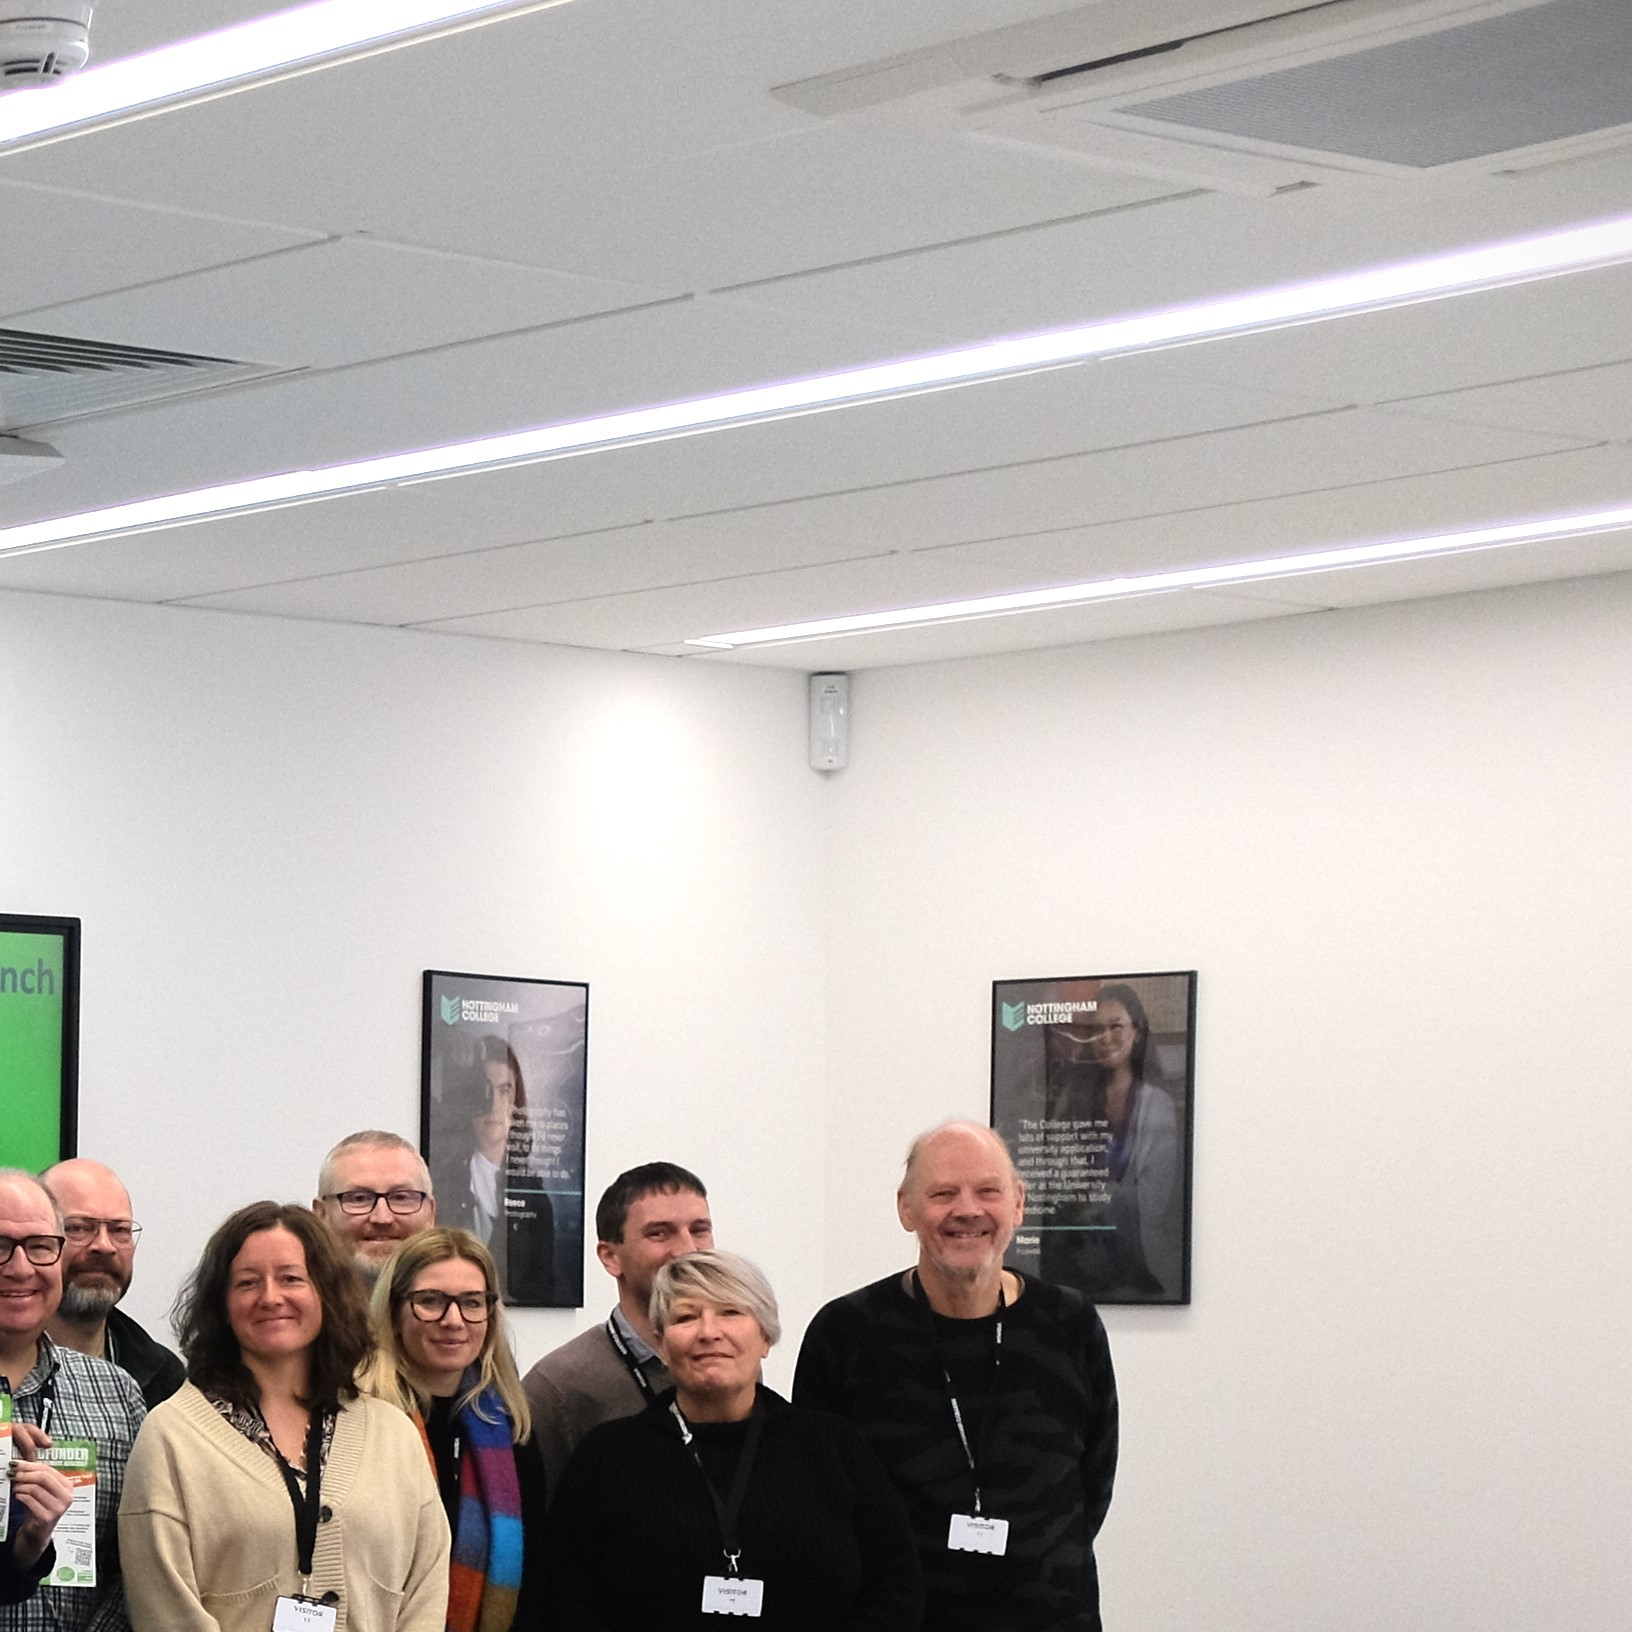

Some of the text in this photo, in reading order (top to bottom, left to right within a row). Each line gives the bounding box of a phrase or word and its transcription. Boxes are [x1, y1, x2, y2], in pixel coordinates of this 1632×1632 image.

[462, 999, 519, 1013] NOTTINGHAM
[1027, 1001, 1097, 1014] NOTTINGHAM
[462, 1011, 500, 1023] COLLEGE
[1027, 1013, 1073, 1025] COLLEGE
[718, 1587, 747, 1596] VISITOR
[294, 1605, 324, 1617] VISITOR
